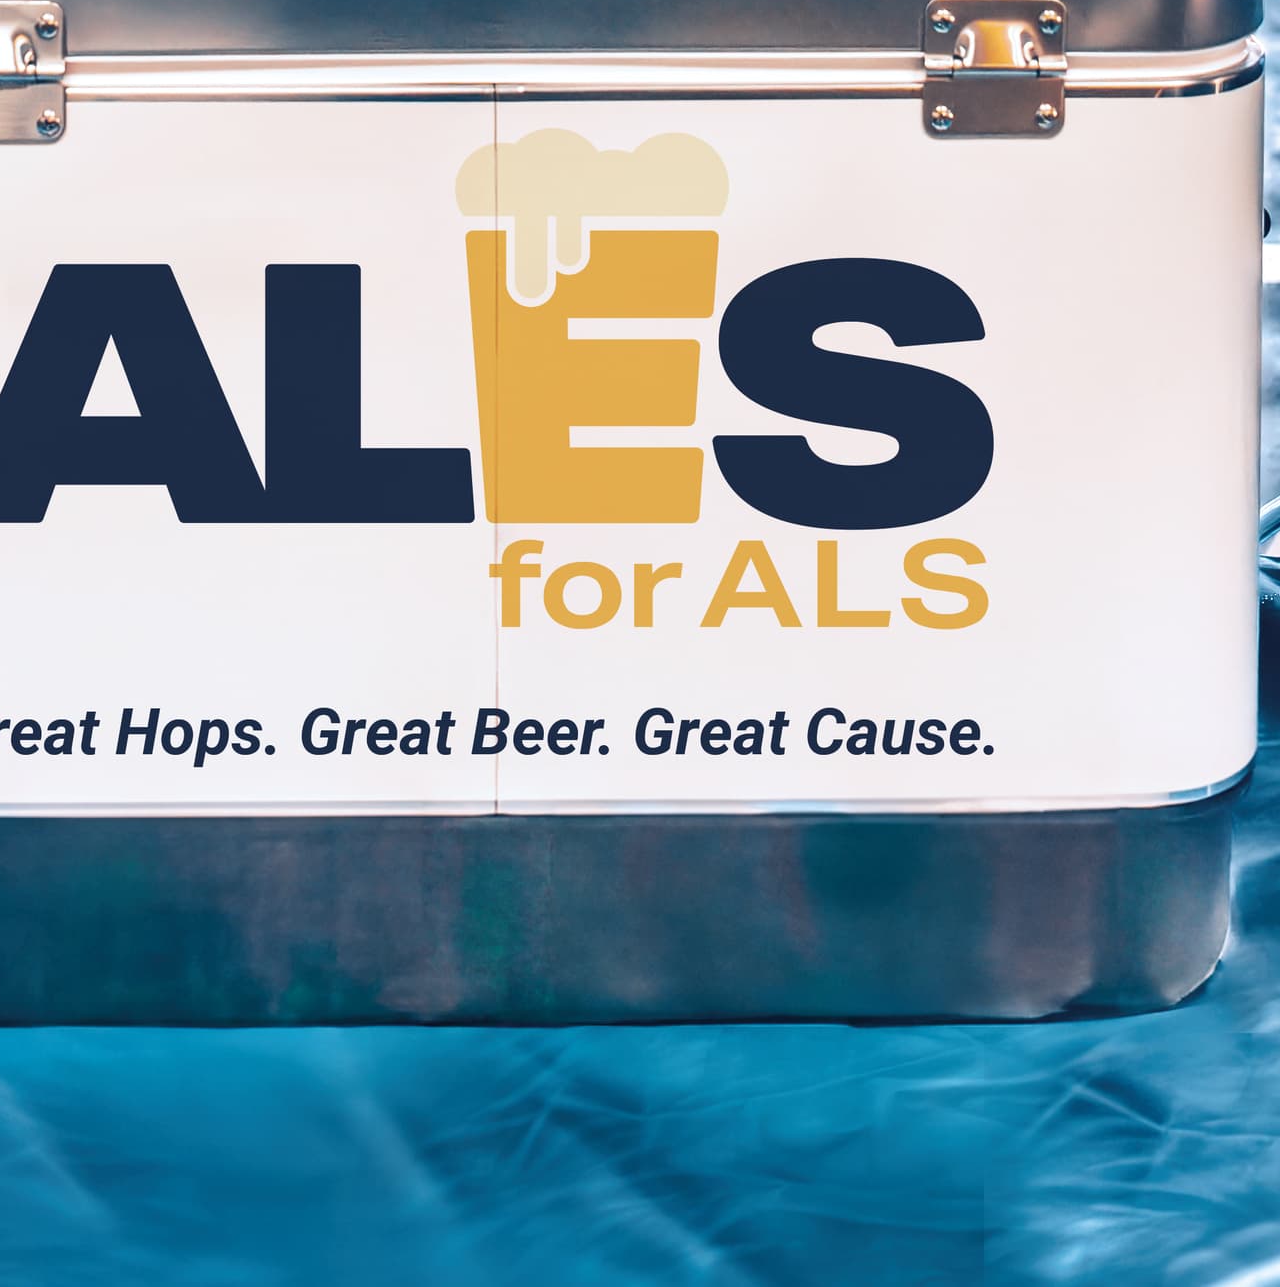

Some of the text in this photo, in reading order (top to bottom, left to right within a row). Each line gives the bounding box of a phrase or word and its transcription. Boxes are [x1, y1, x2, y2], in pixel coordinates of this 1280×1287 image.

[487, 536, 990, 631] for ALS
[114, 706, 277, 769] Hops.
[300, 706, 457, 757] Great
[470, 706, 610, 757] Beer.
[634, 706, 791, 757] Great
[806, 706, 995, 757] Cause.
